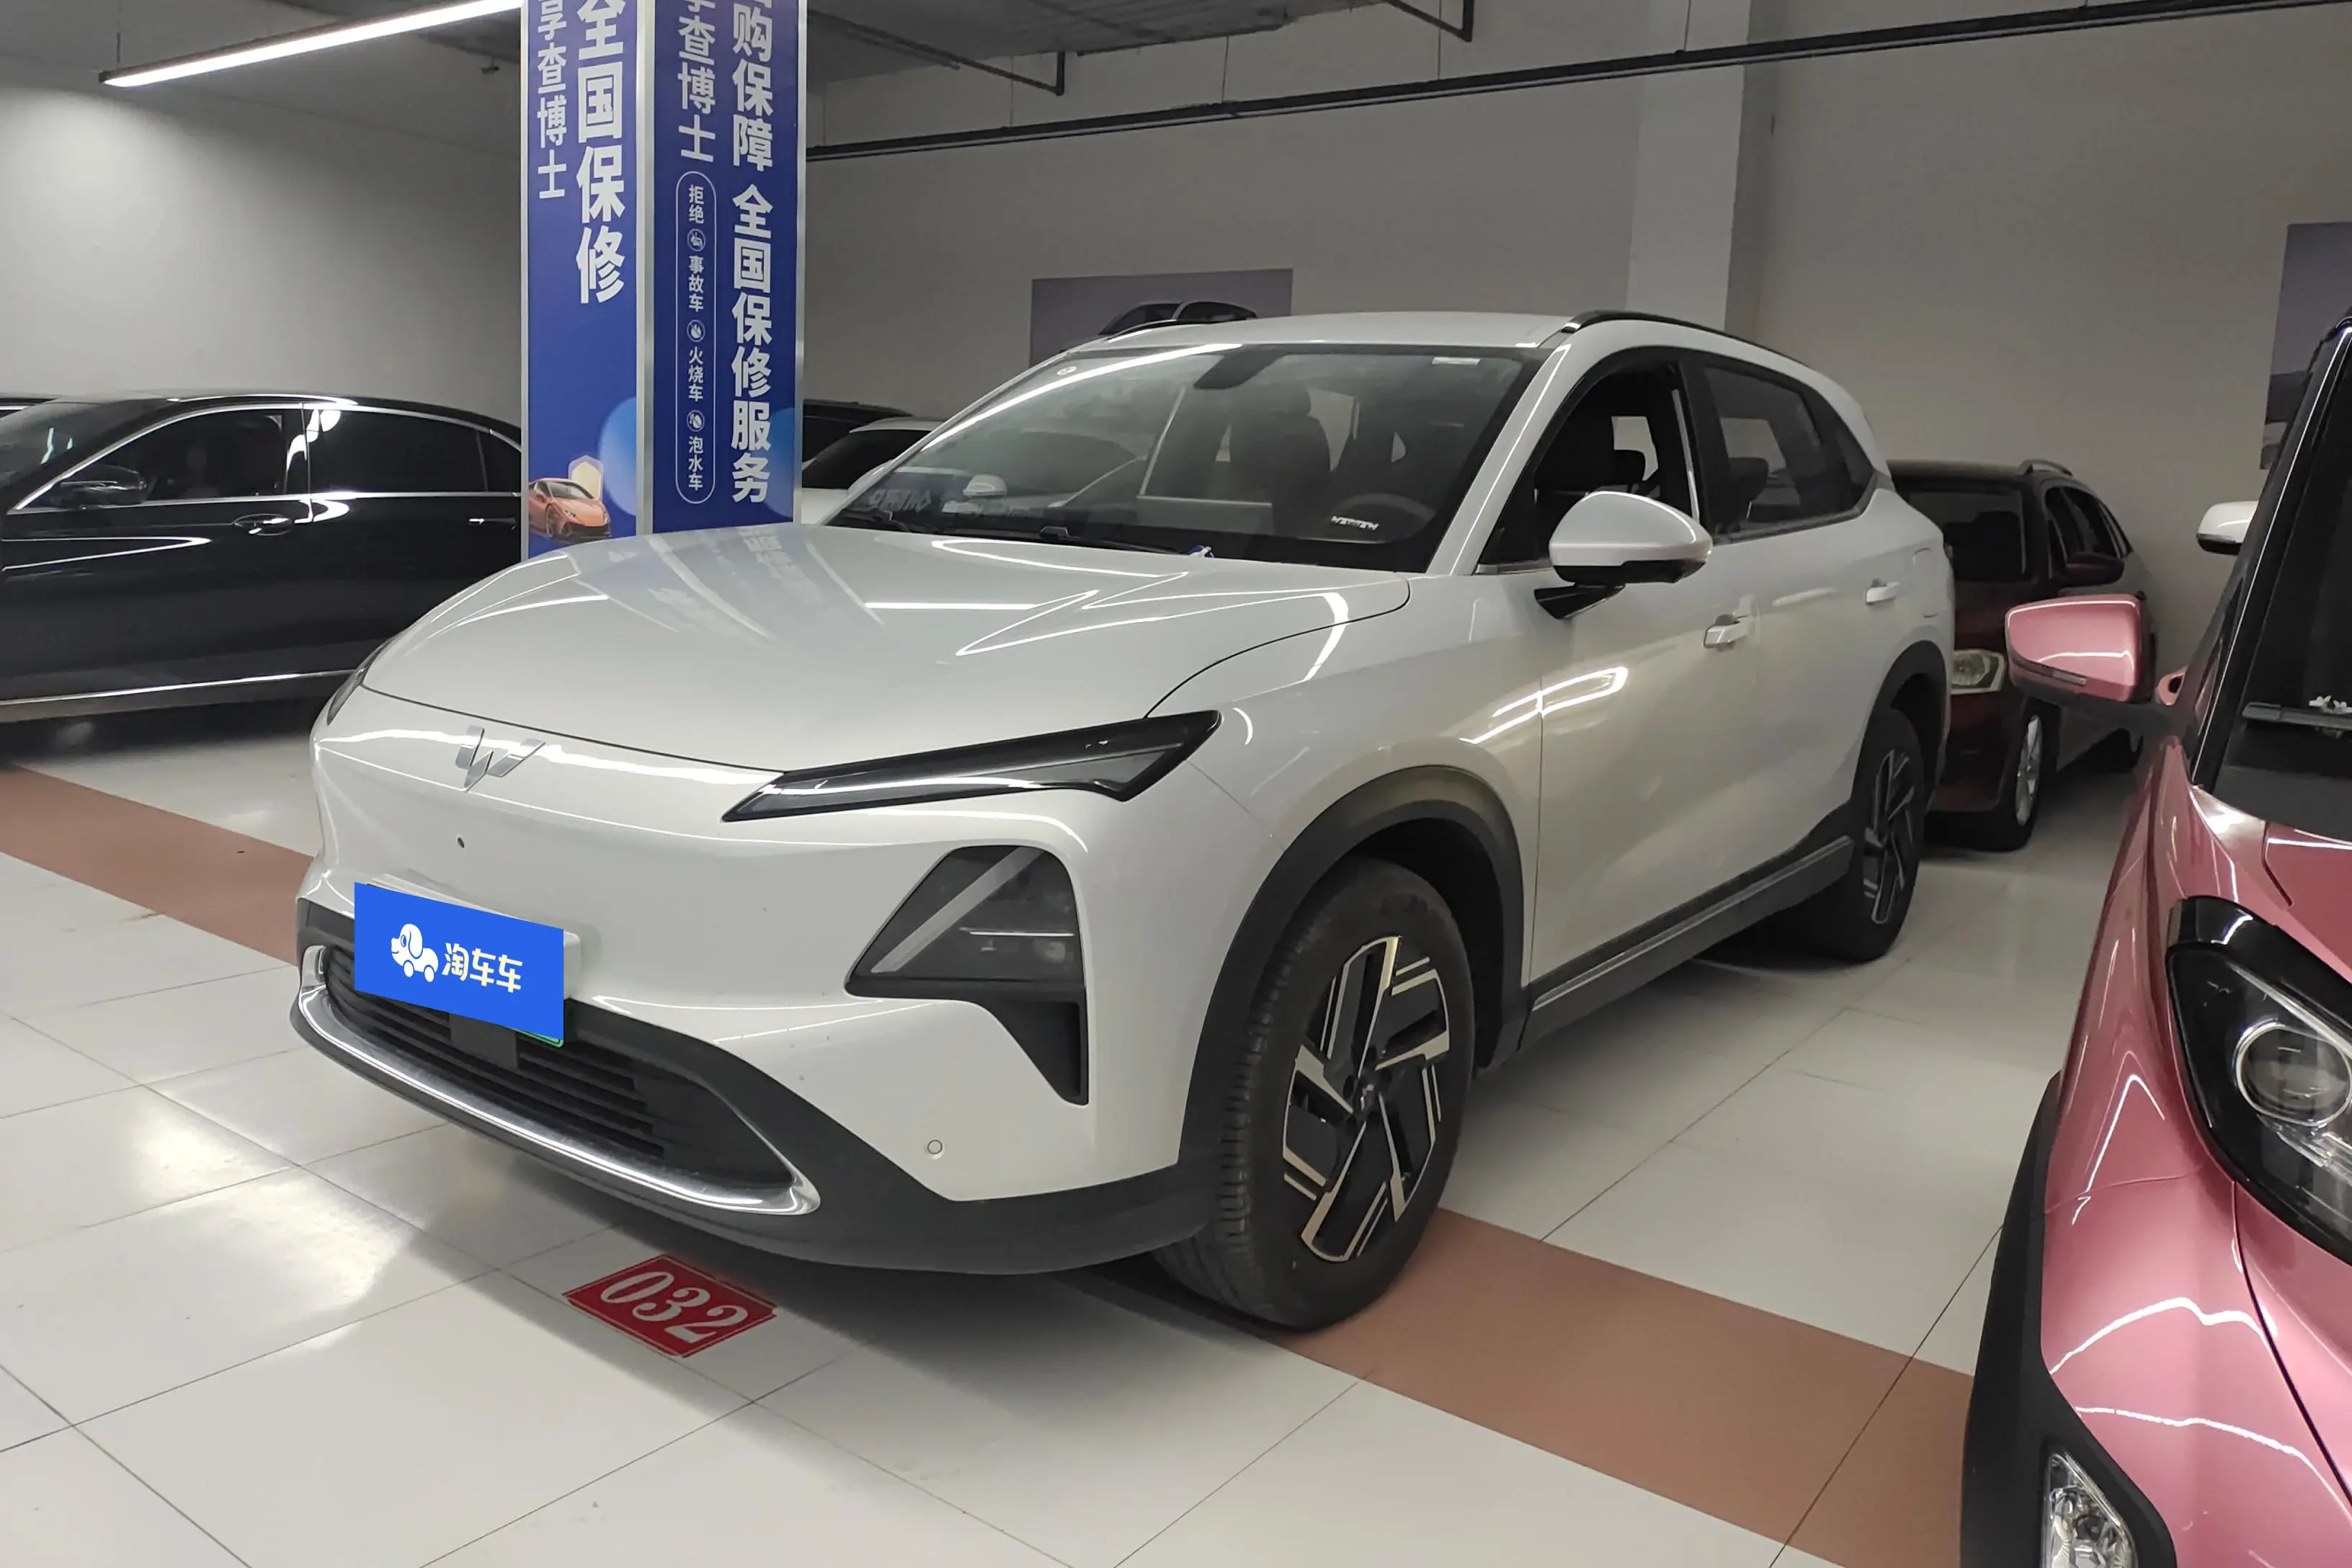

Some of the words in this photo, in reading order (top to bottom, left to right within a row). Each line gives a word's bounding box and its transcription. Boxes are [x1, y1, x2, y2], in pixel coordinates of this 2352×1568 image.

[537, 0, 567, 199] 享查博士
[732, 0, 773, 172] 购保障
[576, 0, 626, 304] 全国保修
[688, 184, 705, 224] 拒绝
[688, 255, 704, 313] 事故车
[688, 346, 704, 402] 火烧车
[731, 184, 773, 503] 全国保修服务
[688, 436, 704, 491] 泡水车
[600, 1271, 749, 1343] 032
